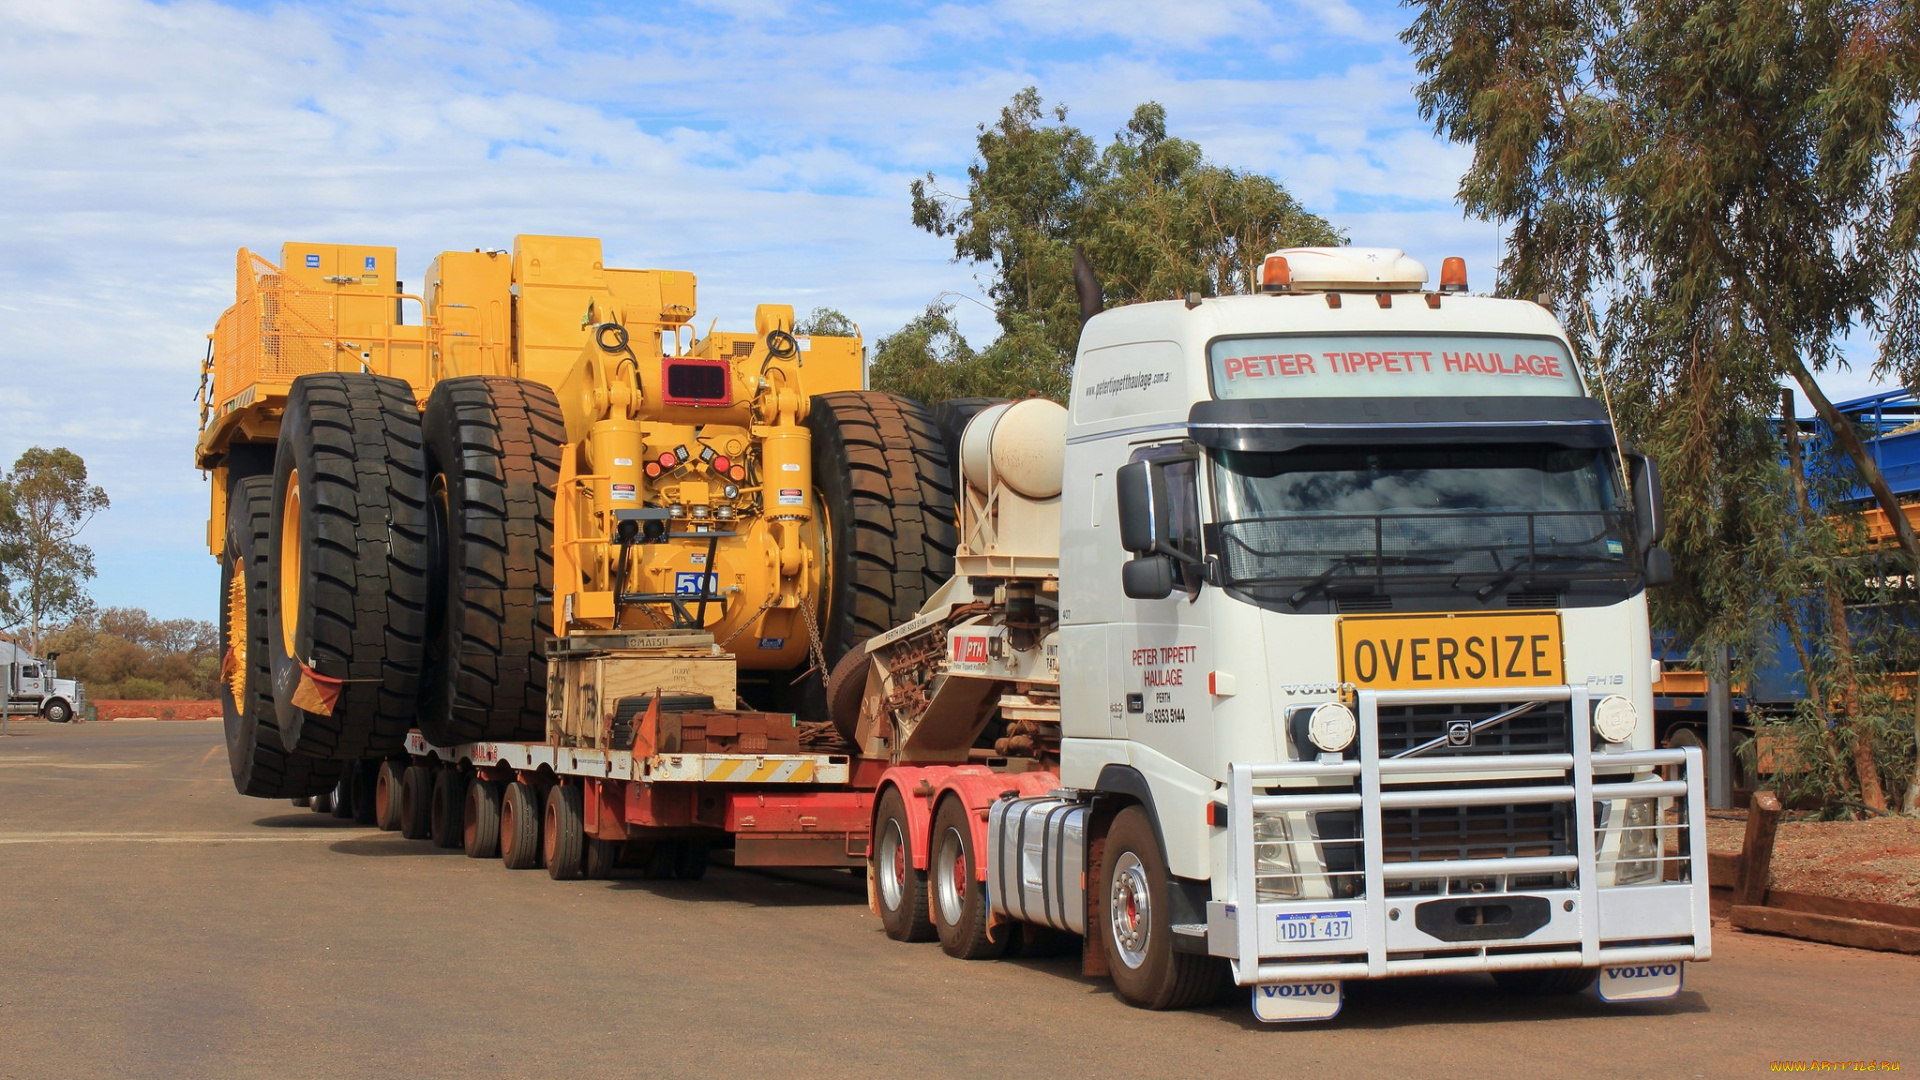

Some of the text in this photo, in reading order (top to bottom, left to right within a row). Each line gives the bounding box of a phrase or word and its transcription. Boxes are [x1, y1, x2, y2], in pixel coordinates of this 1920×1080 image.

[1224, 351, 1565, 381] PETER TIPPETT HAULAGE
[624, 638, 669, 647] KOMATSU
[967, 641, 984, 658] PTH
[1132, 646, 1196, 666] PETER TIPPETT
[1355, 635, 1552, 683] OVERSIZE
[1144, 669, 1183, 687] HAULAGE
[1281, 682, 1357, 696] VOLVO
[1156, 692, 1171, 703] PERTH
[1154, 709, 1169, 723] 9353
[1170, 708, 1185, 723] 5144
[471, 745, 498, 760] HAULGE
[1605, 964, 1678, 979] VOLVO
[1261, 983, 1336, 998] VOLVO
